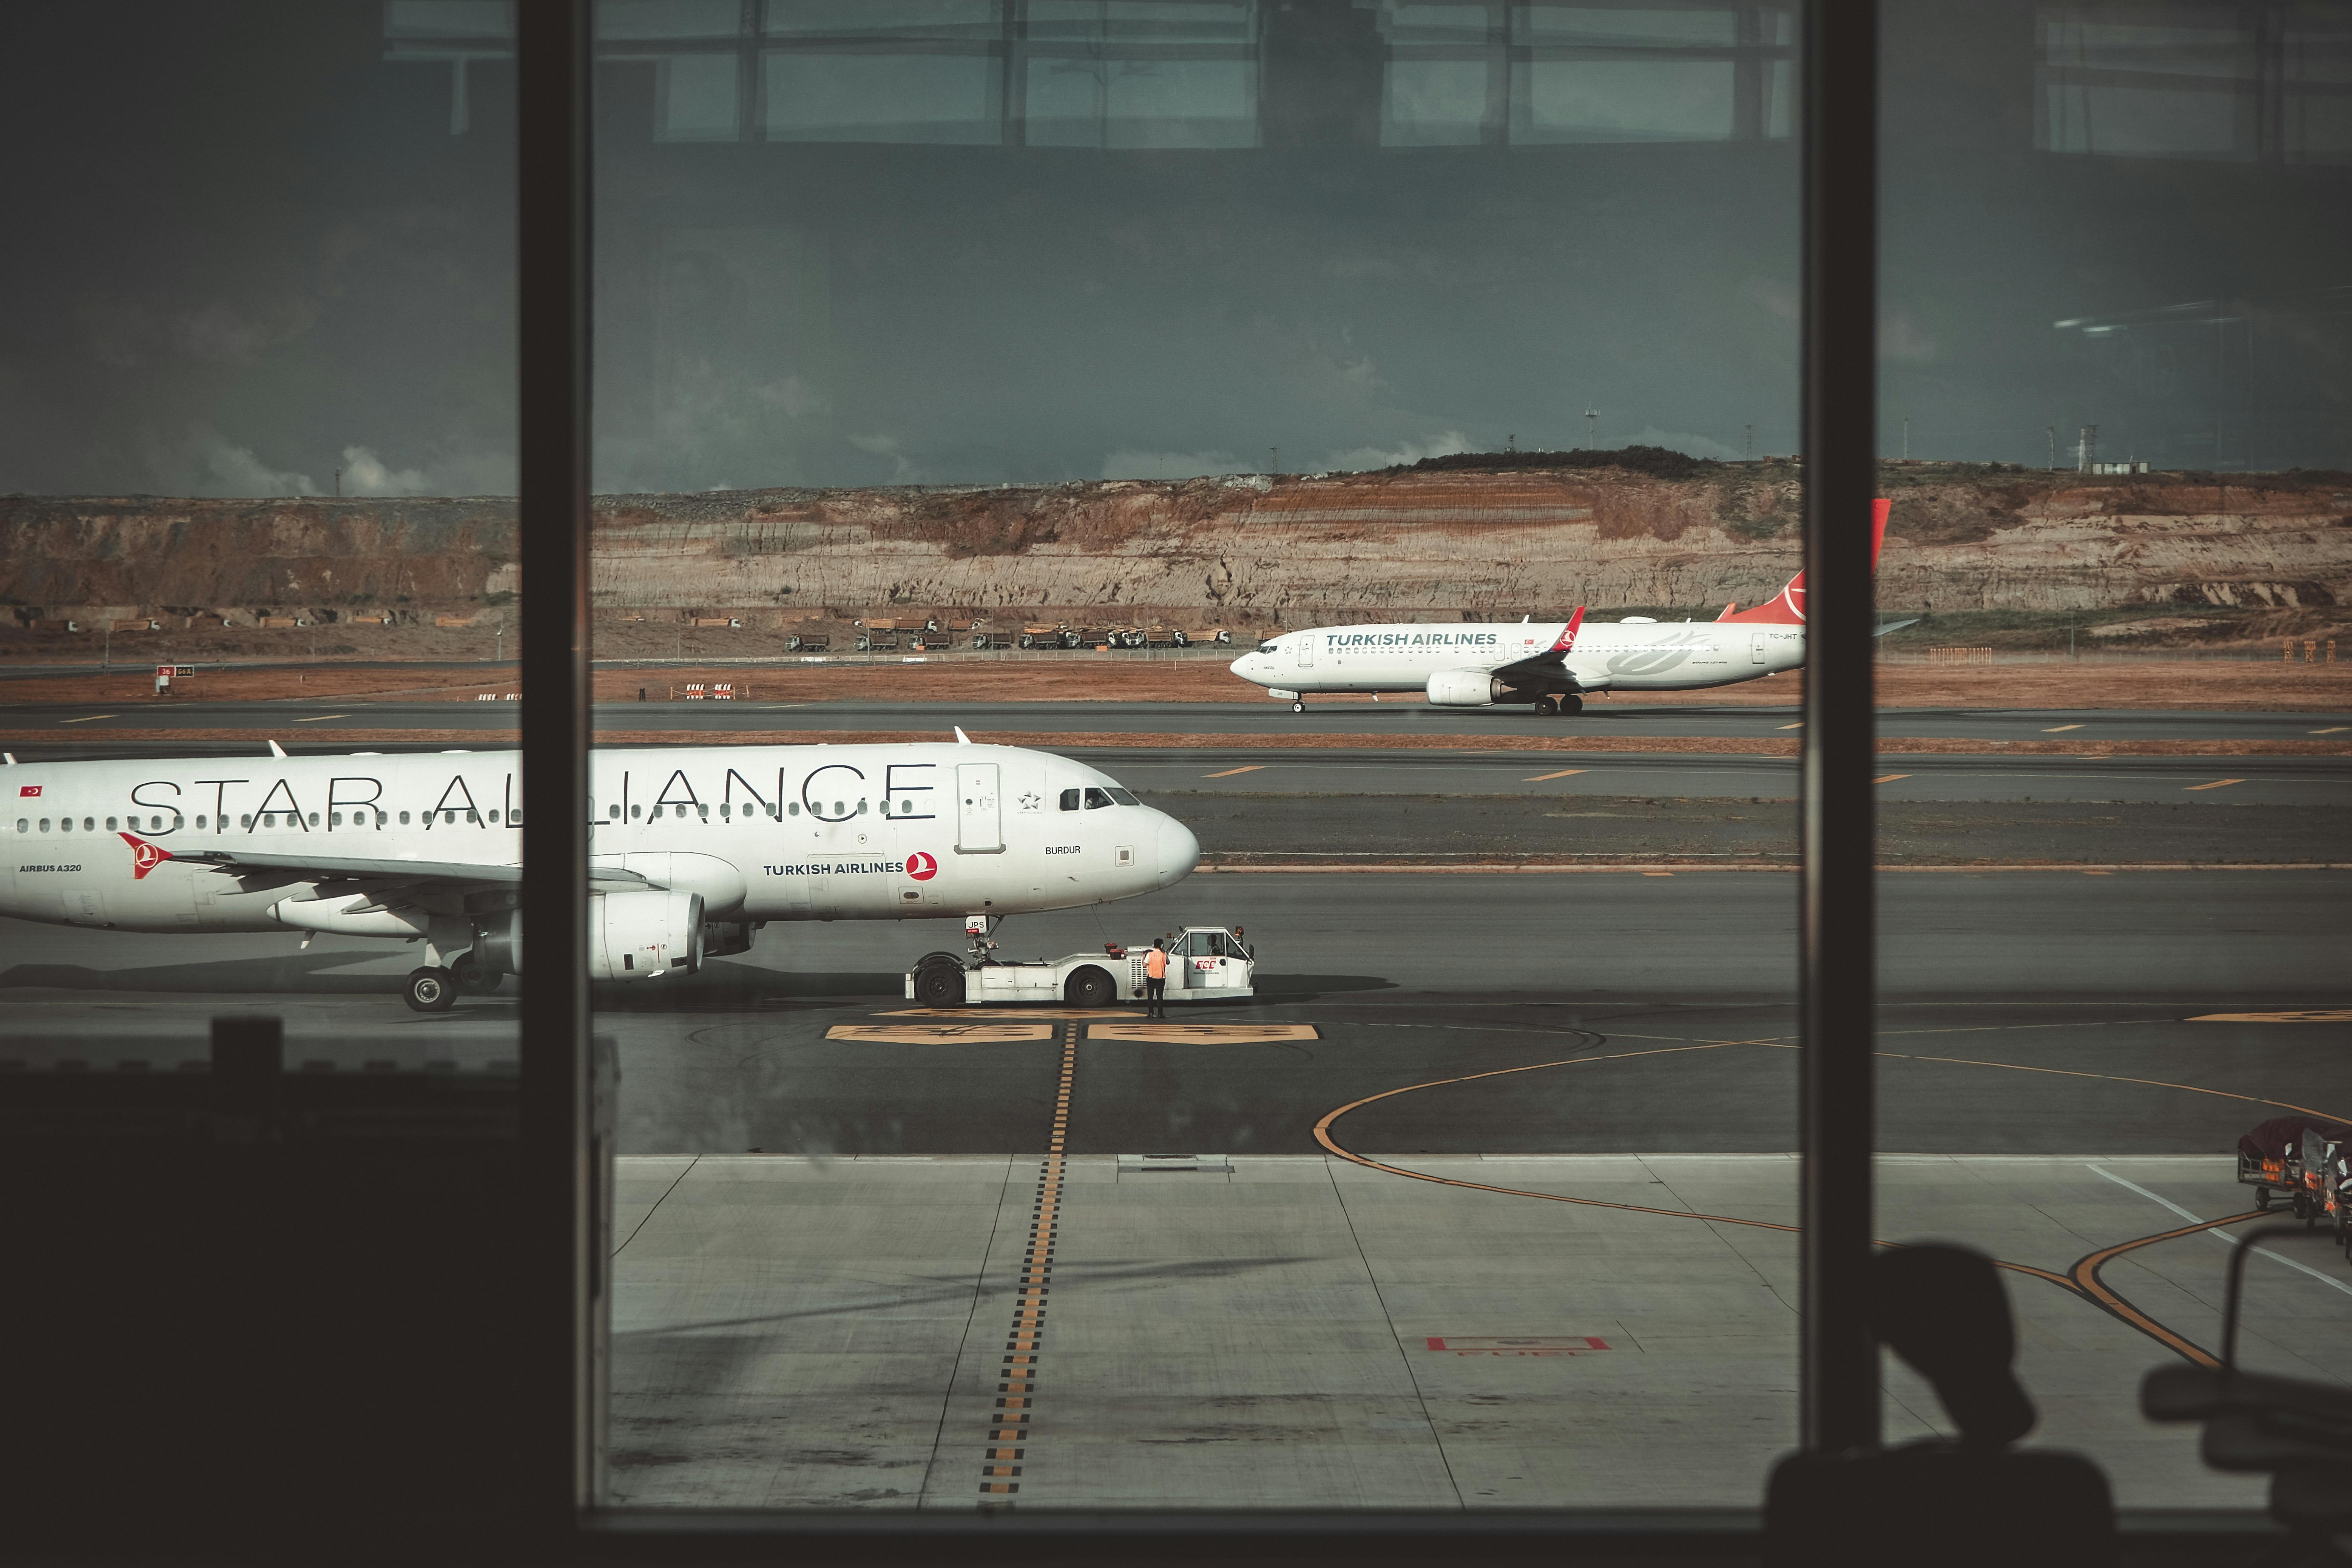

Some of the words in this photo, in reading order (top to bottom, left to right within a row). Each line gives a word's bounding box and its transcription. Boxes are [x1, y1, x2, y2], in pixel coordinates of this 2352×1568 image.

[1327, 633, 1408, 646] TURKISH
[1411, 634, 1497, 645] AIRLINES
[128, 777, 381, 836] STAR
[426, 764, 936, 830] ALIANCE
[1045, 846, 1080, 855] BURDUR
[763, 864, 830, 876] TURKISH
[834, 862, 904, 874] AIRLINES
